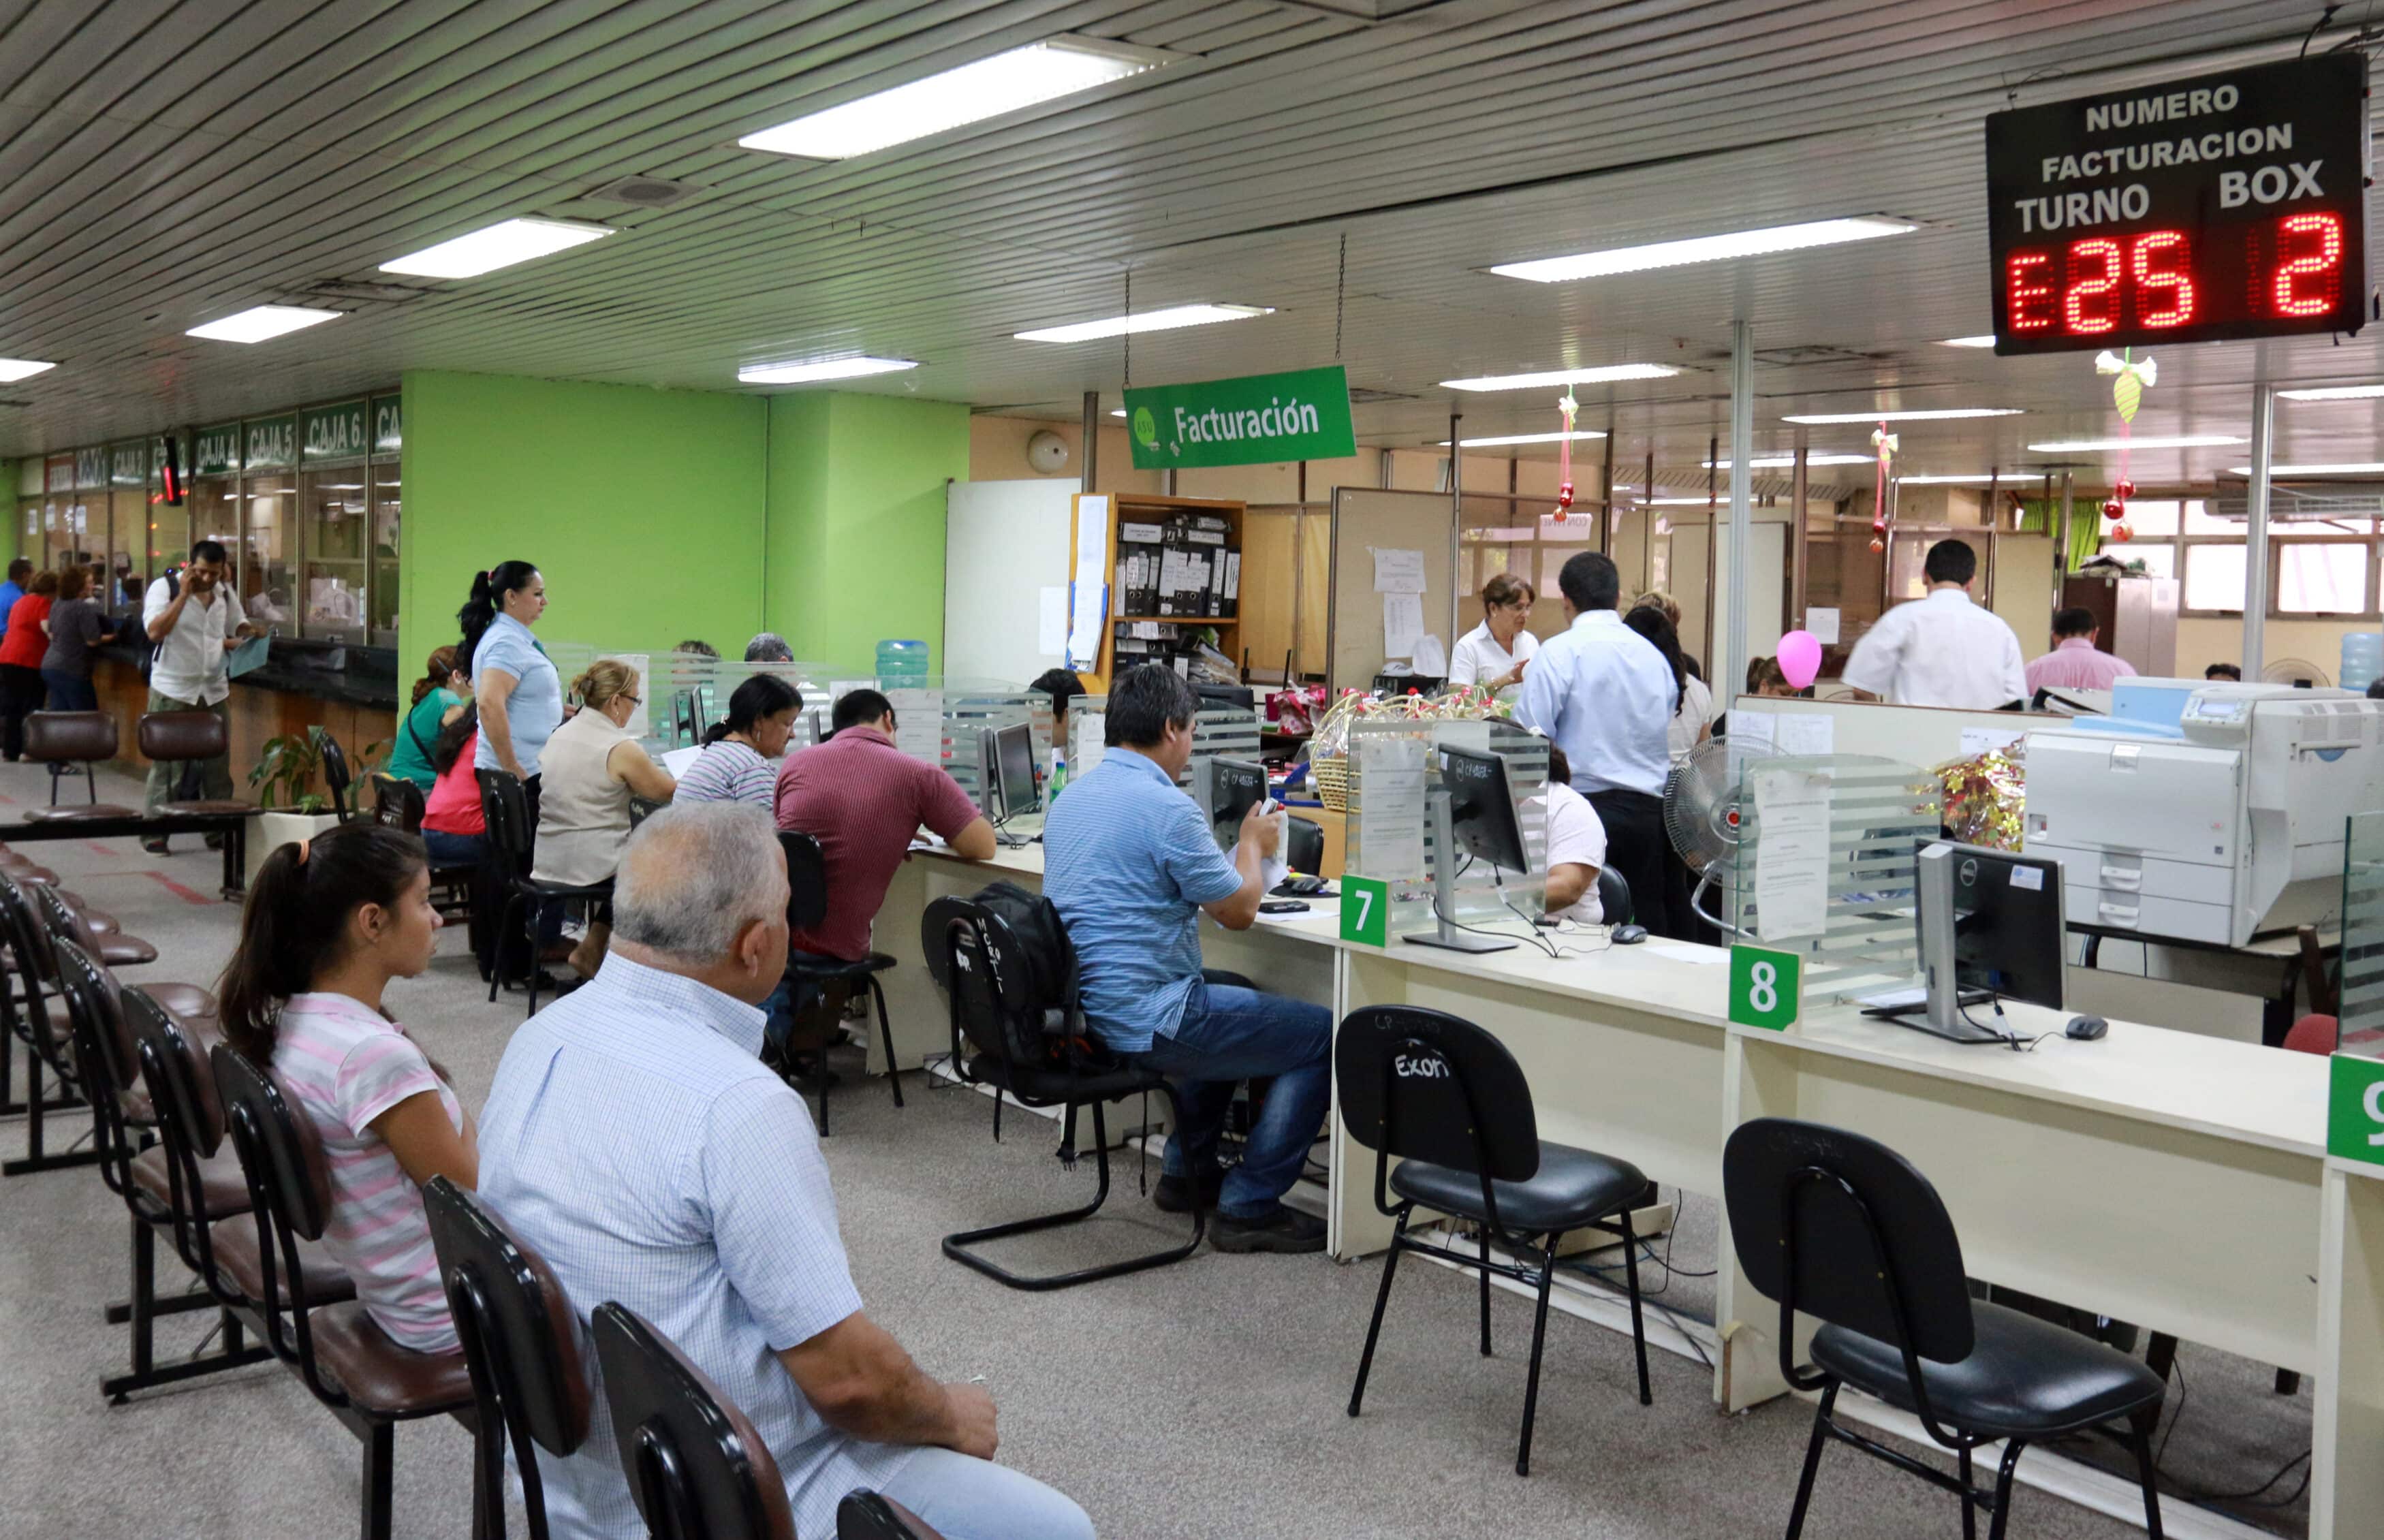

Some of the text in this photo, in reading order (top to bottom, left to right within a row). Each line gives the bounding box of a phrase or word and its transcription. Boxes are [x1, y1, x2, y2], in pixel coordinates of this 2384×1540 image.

[2086, 84, 2240, 132] NUMERO
[2042, 123, 2293, 183] FACTURACION
[2219, 159, 2324, 208] BOX
[2015, 184, 2150, 233] TURNO
[2276, 215, 2340, 315] 2
[250, 423, 292, 460] CAJA 5
[309, 411, 360, 451] CAJA 6
[377, 405, 401, 439] CA
[1174, 396, 1319, 443] Facturación
[198, 435, 227, 467] CAJA
[228, 434, 236, 462] 4
[1355, 890, 1373, 932] 7
[1748, 961, 1778, 1013] 8
[1394, 1054, 1450, 1079] Exon
[2362, 1080, 2384, 1146] 9
